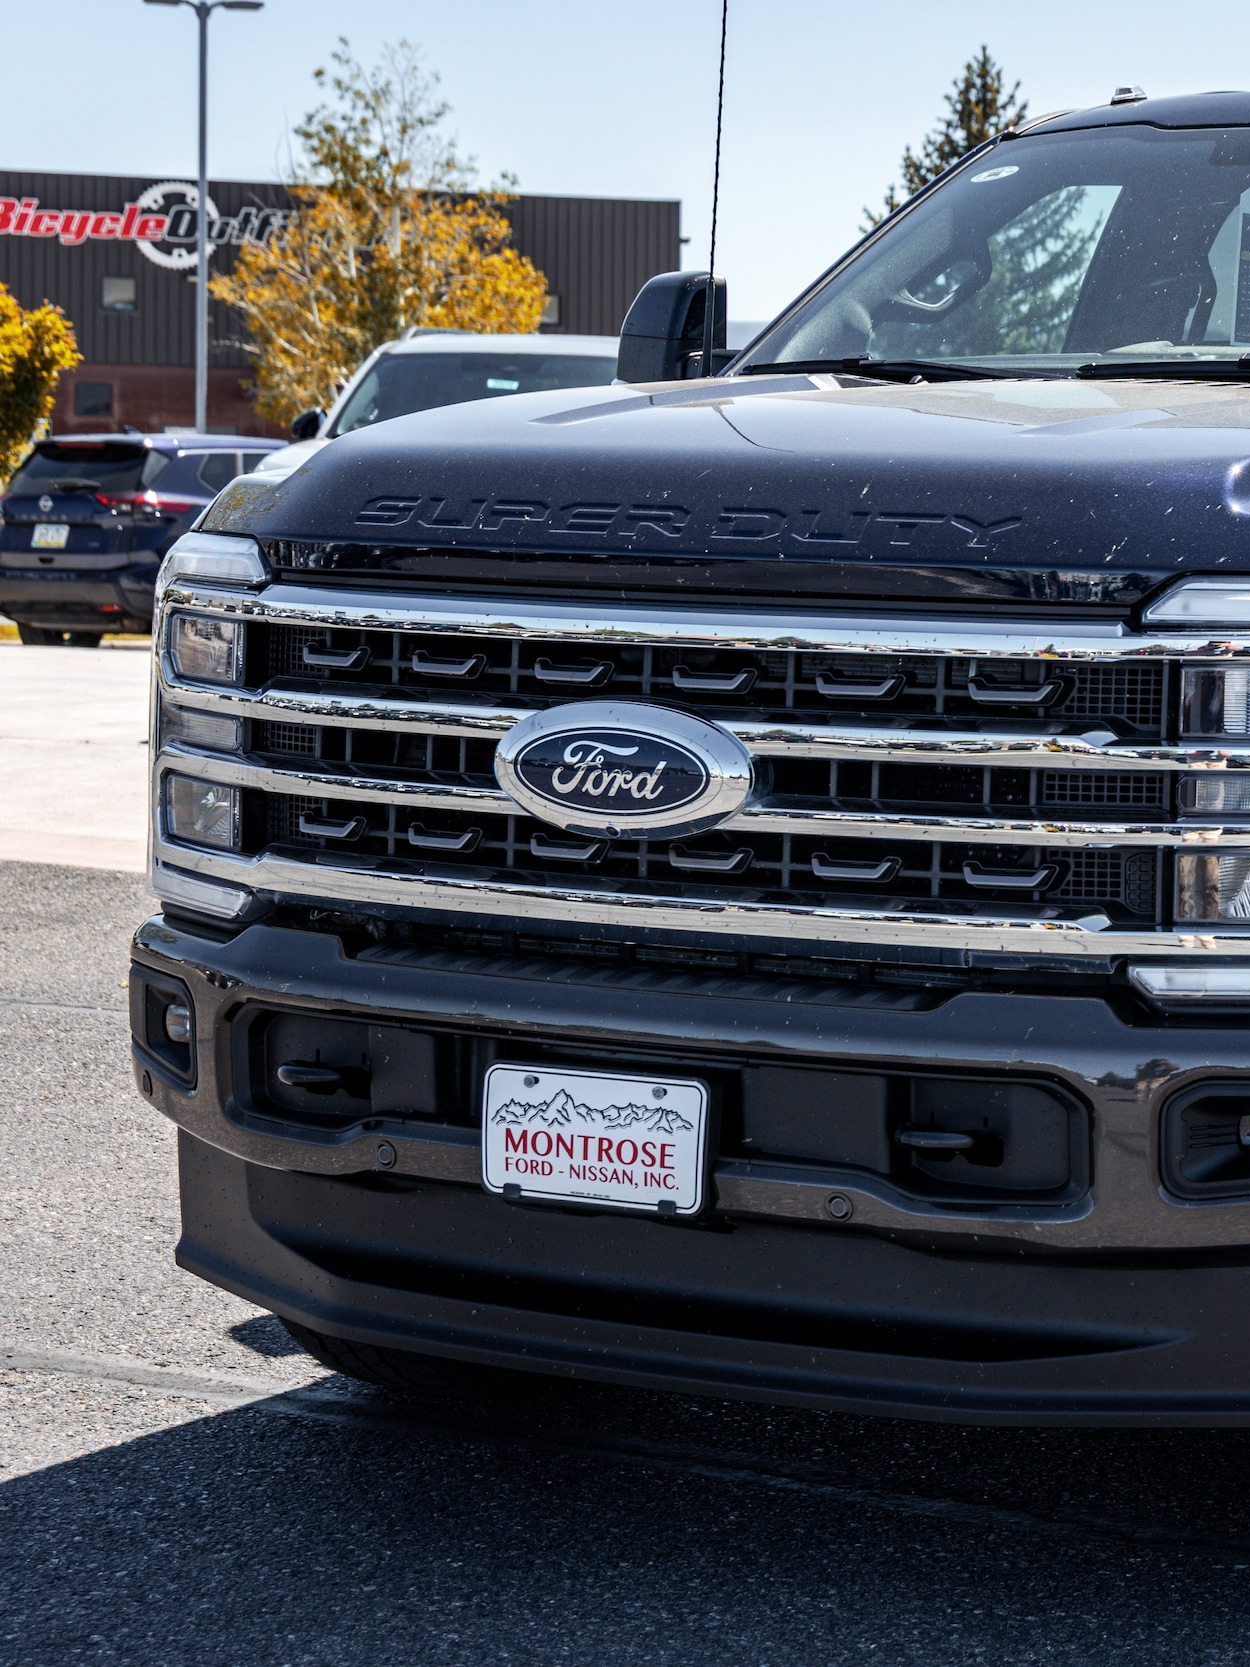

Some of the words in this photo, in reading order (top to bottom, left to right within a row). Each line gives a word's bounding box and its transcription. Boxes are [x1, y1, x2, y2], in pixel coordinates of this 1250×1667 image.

[0, 197, 169, 246] Bicycle
[353, 494, 693, 540] SUPER
[709, 506, 1024, 548] DUTY
[552, 739, 668, 801] Ford
[505, 1127, 677, 1170] MONTROSE
[505, 1156, 553, 1177] FORD
[569, 1163, 639, 1189] NISSAN,
[644, 1171, 680, 1191] INC.
